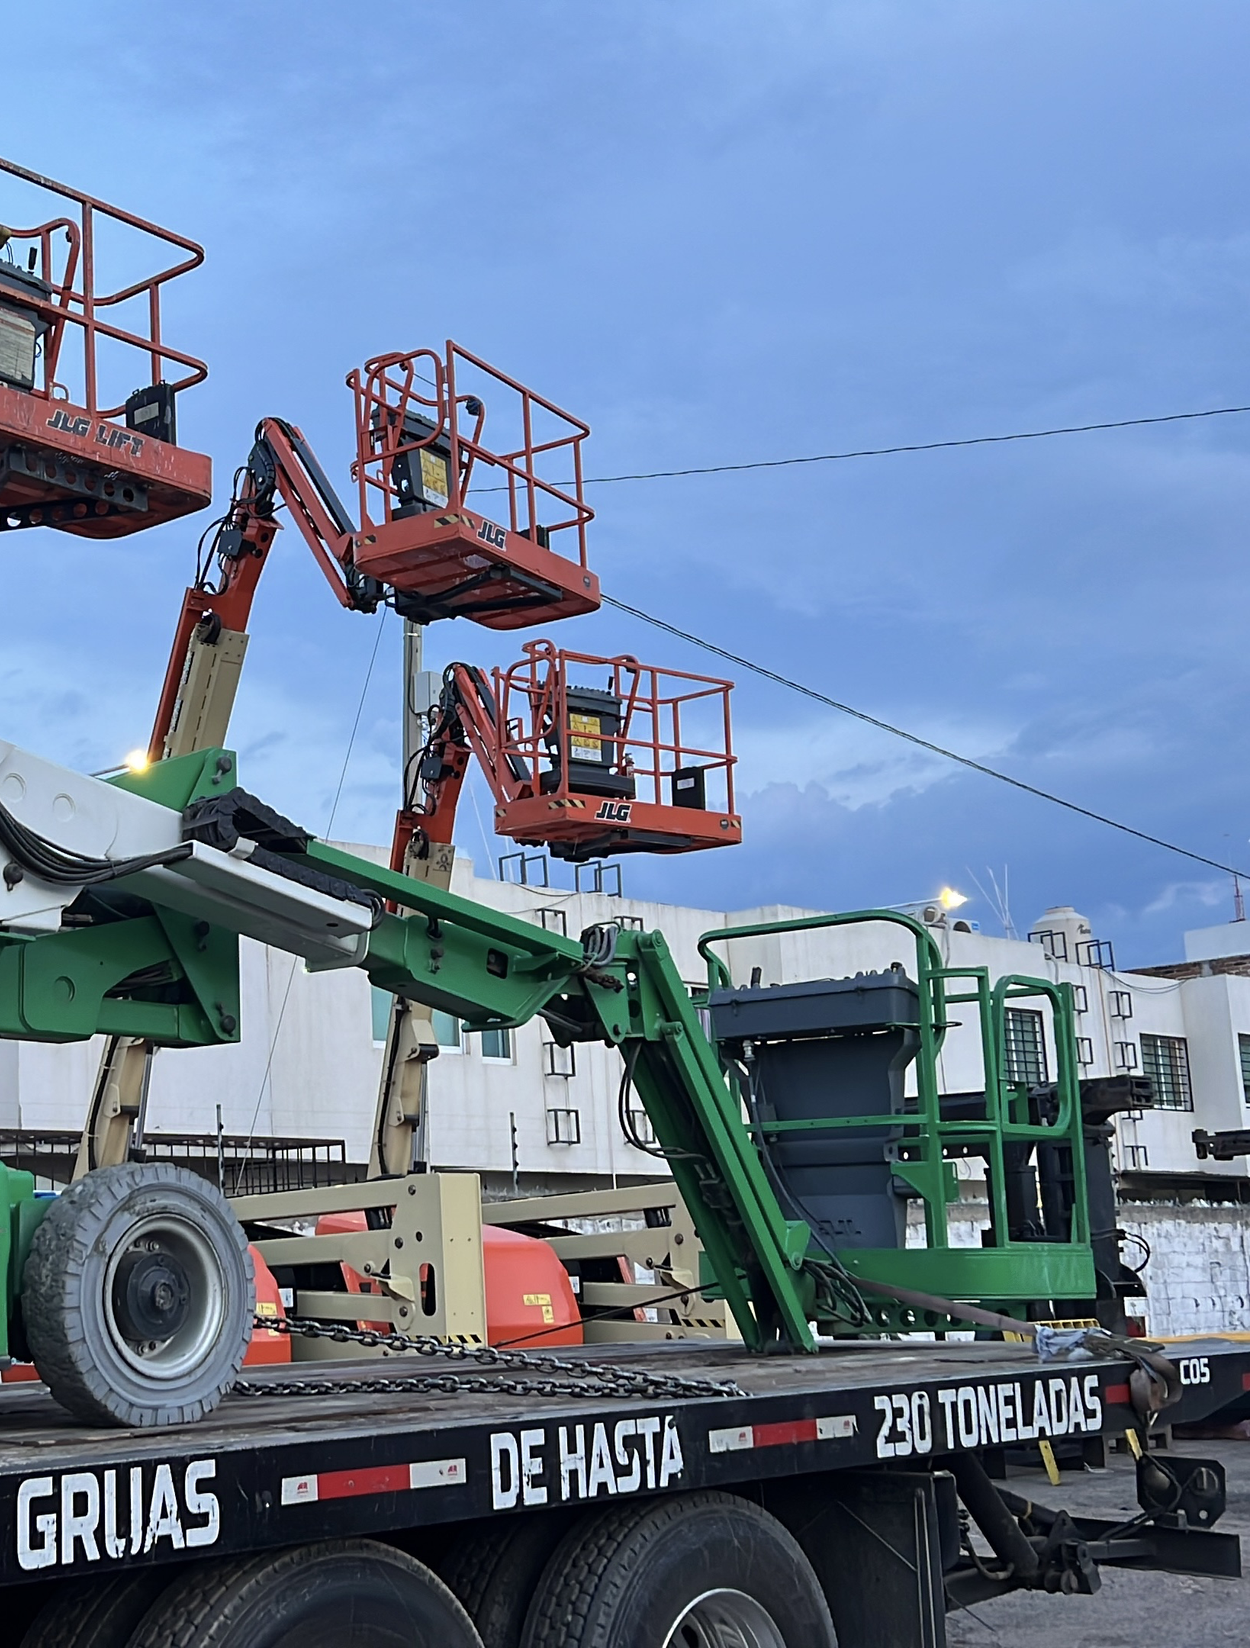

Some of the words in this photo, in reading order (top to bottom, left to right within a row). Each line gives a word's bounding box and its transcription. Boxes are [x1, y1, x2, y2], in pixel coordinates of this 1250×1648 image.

[46, 409, 92, 437] JLG
[93, 423, 145, 457] LIFT
[477, 519, 507, 551] JLG
[594, 800, 632, 824] JLG
[17, 1459, 220, 1571] GRUAS
[490, 1428, 548, 1510] DE
[558, 1415, 685, 1501] HASTA
[873, 1390, 932, 1459] 230
[937, 1374, 1103, 1450] TONELADAS
